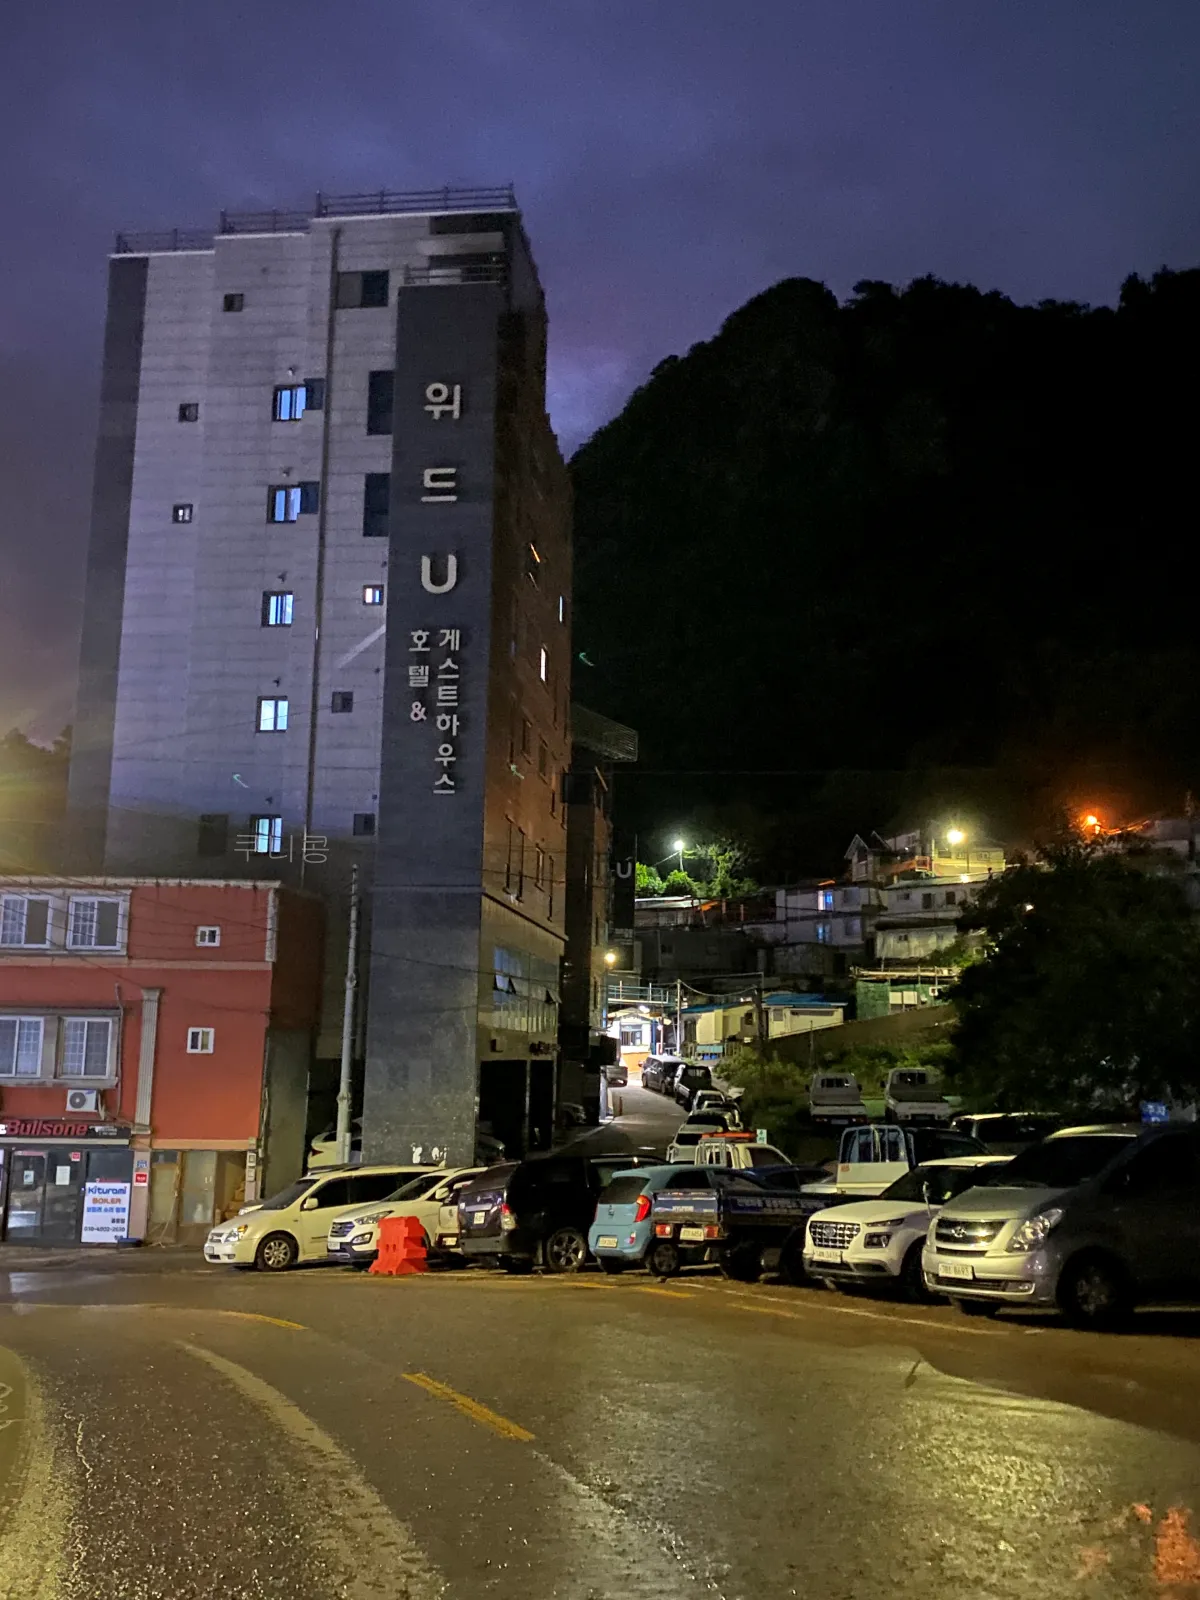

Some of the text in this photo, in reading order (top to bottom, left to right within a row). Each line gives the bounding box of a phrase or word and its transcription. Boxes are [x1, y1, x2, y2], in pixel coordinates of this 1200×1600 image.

[408, 629, 431, 722] 호텔 &
[432, 628, 461, 795] 게스트하우스
[6, 1119, 89, 1136] Bullsone
